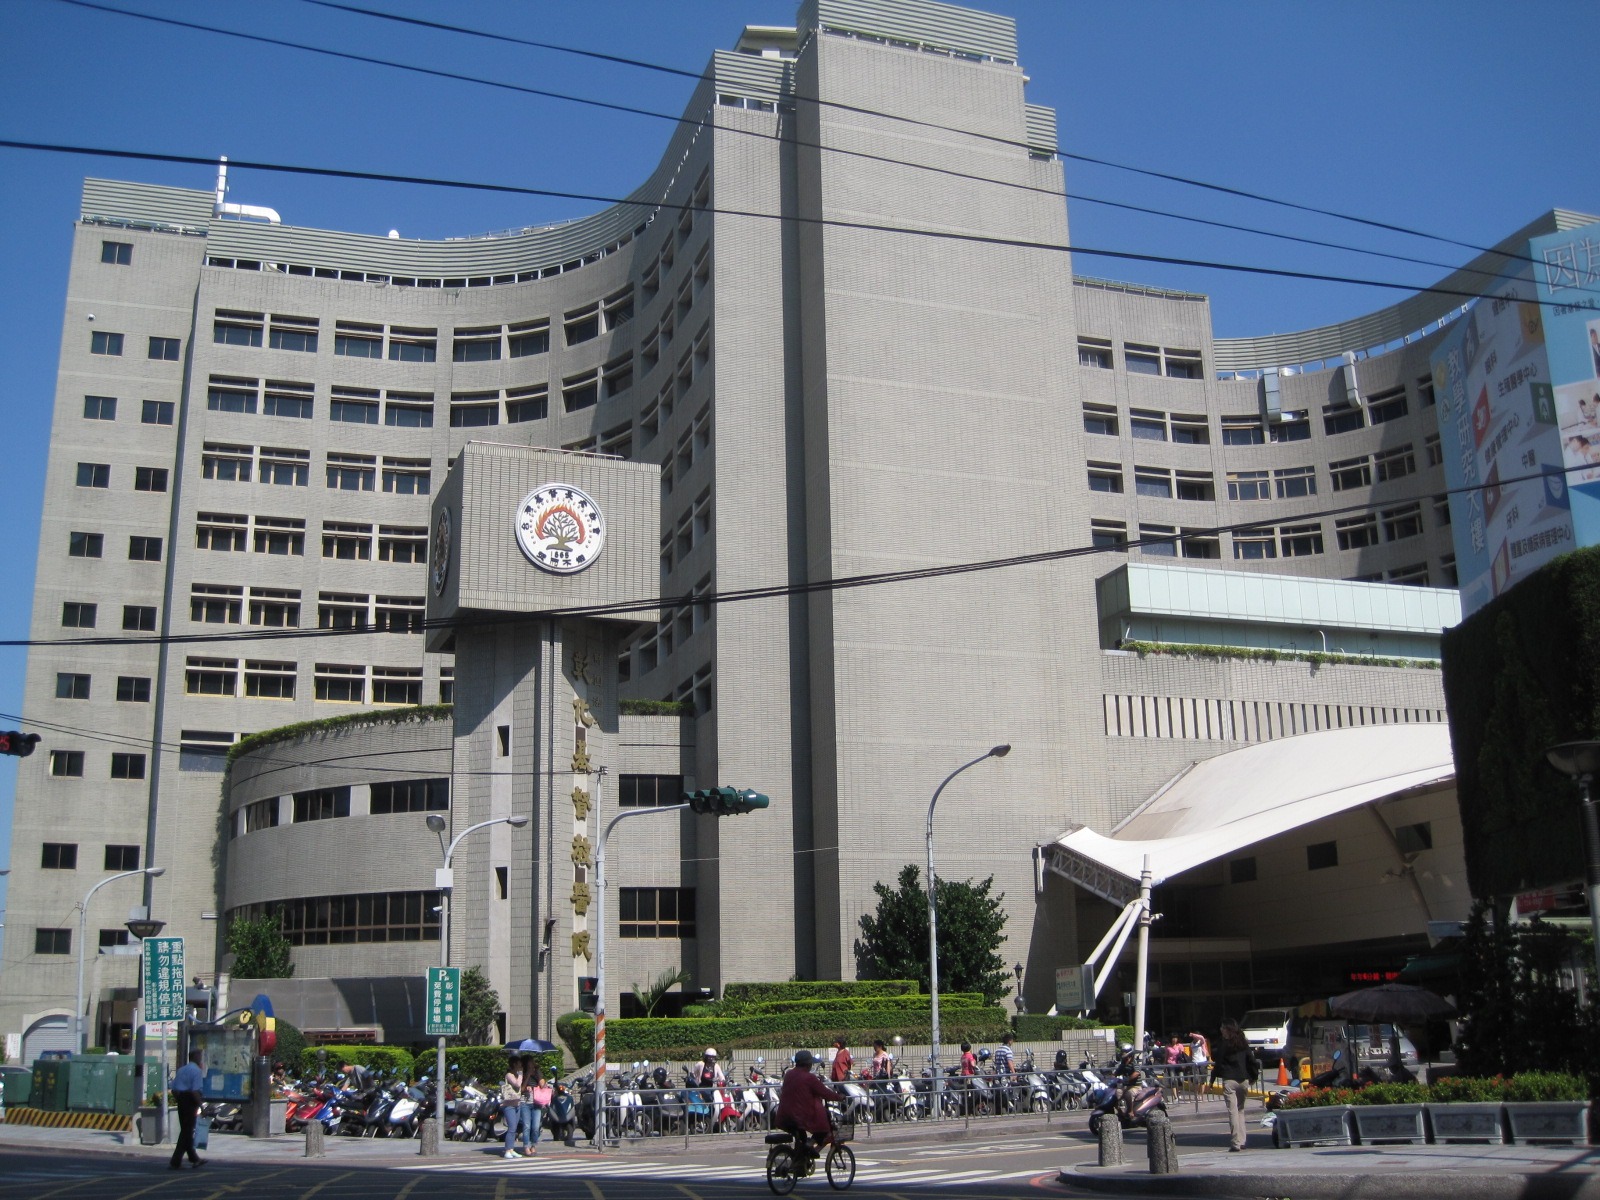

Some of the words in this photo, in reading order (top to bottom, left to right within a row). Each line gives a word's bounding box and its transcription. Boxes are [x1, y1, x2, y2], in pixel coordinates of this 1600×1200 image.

[157, 941, 170, 1018] 請勿違規停車
[171, 941, 183, 1017] 重點拖吊路段
[438, 969, 447, 981] P
[432, 981, 442, 1023] 免費停車場
[445, 981, 454, 1023] 彰基機車
